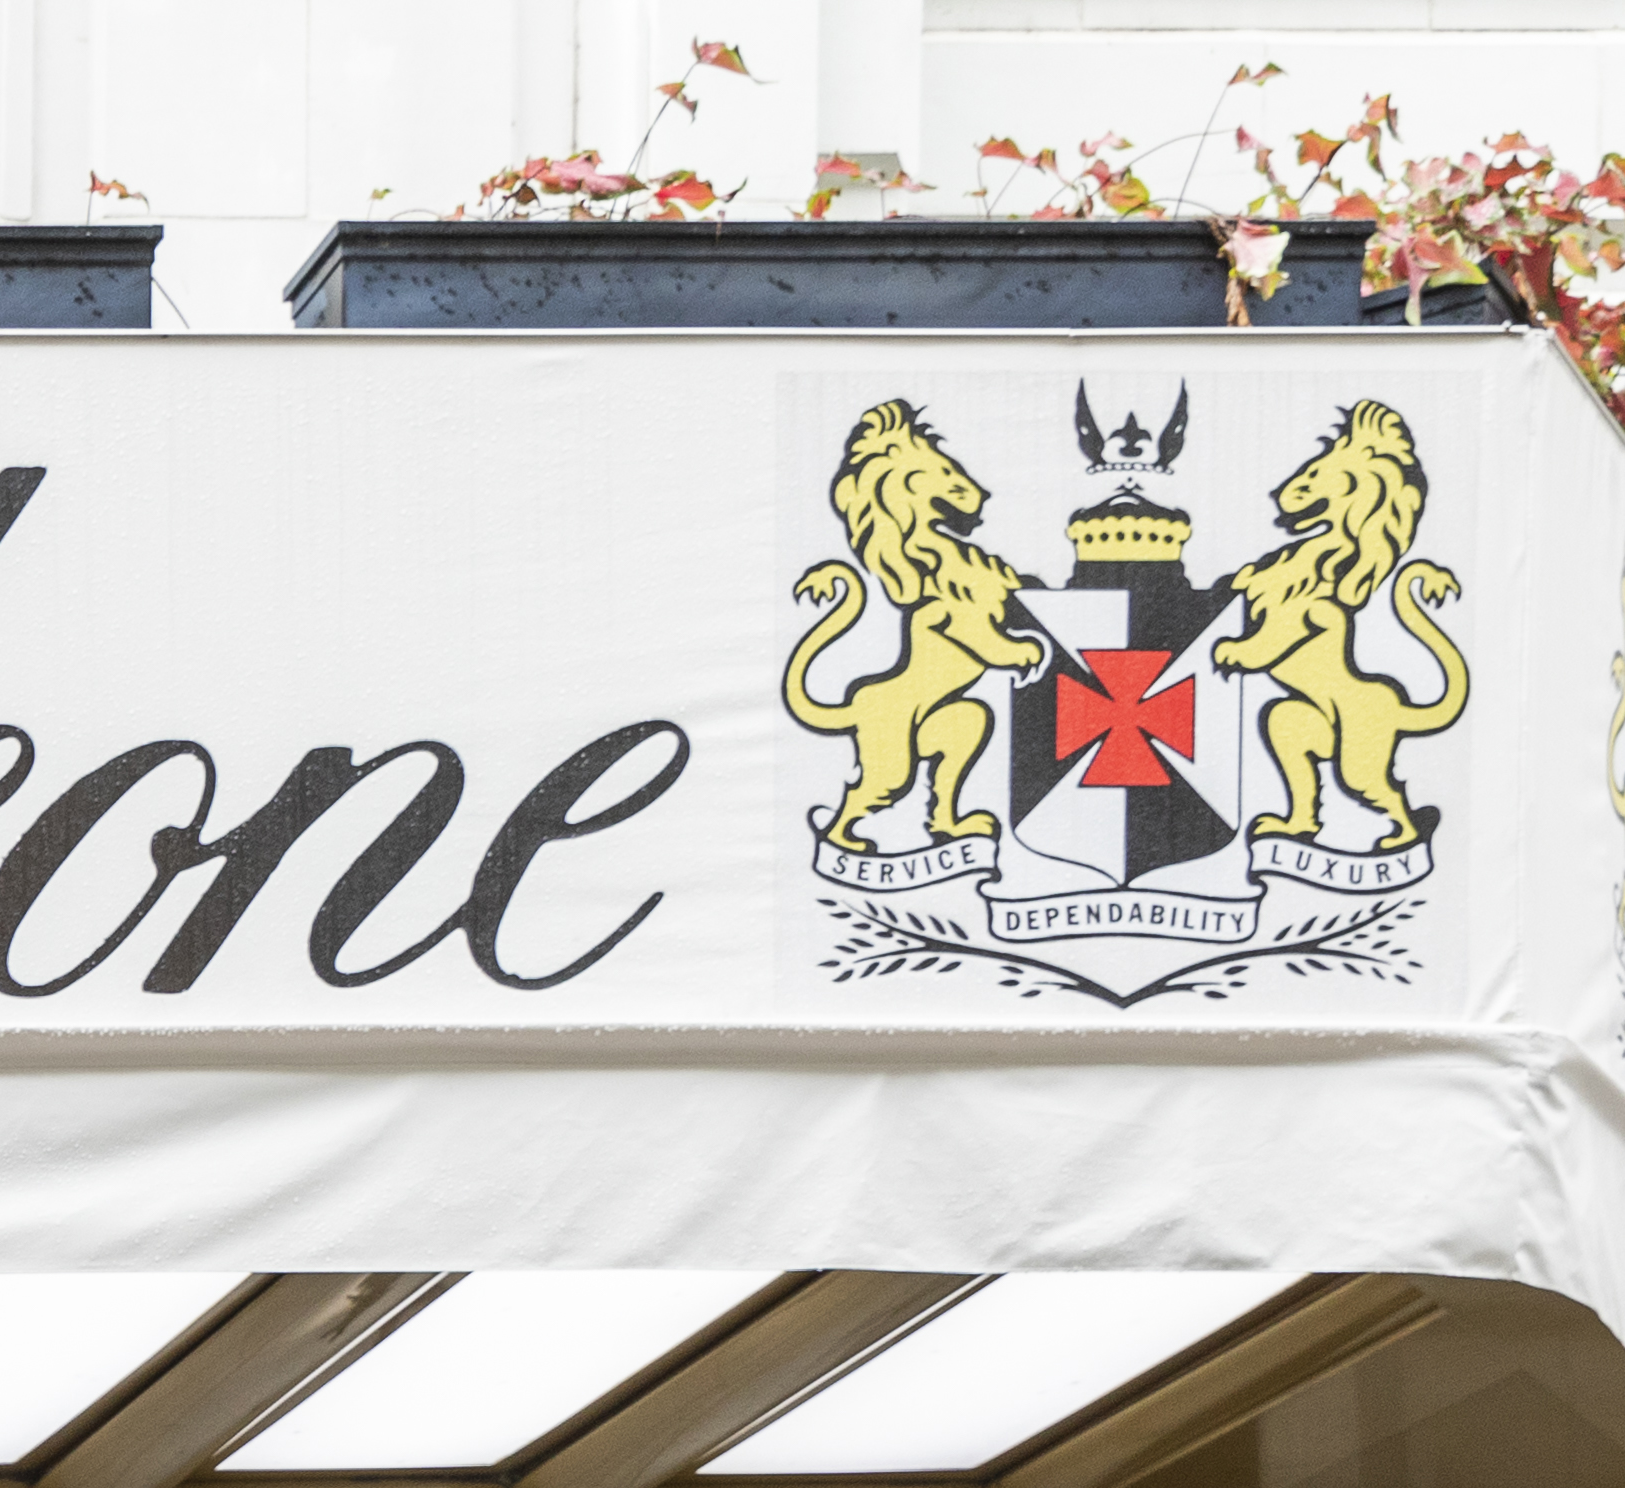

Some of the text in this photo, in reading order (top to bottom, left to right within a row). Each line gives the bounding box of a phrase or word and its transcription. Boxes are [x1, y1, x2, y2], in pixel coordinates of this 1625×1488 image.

[832, 844, 977, 886] SERVICE
[1269, 844, 1416, 882] LUXURY
[1006, 905, 1247, 934] DEPENDABILITY
